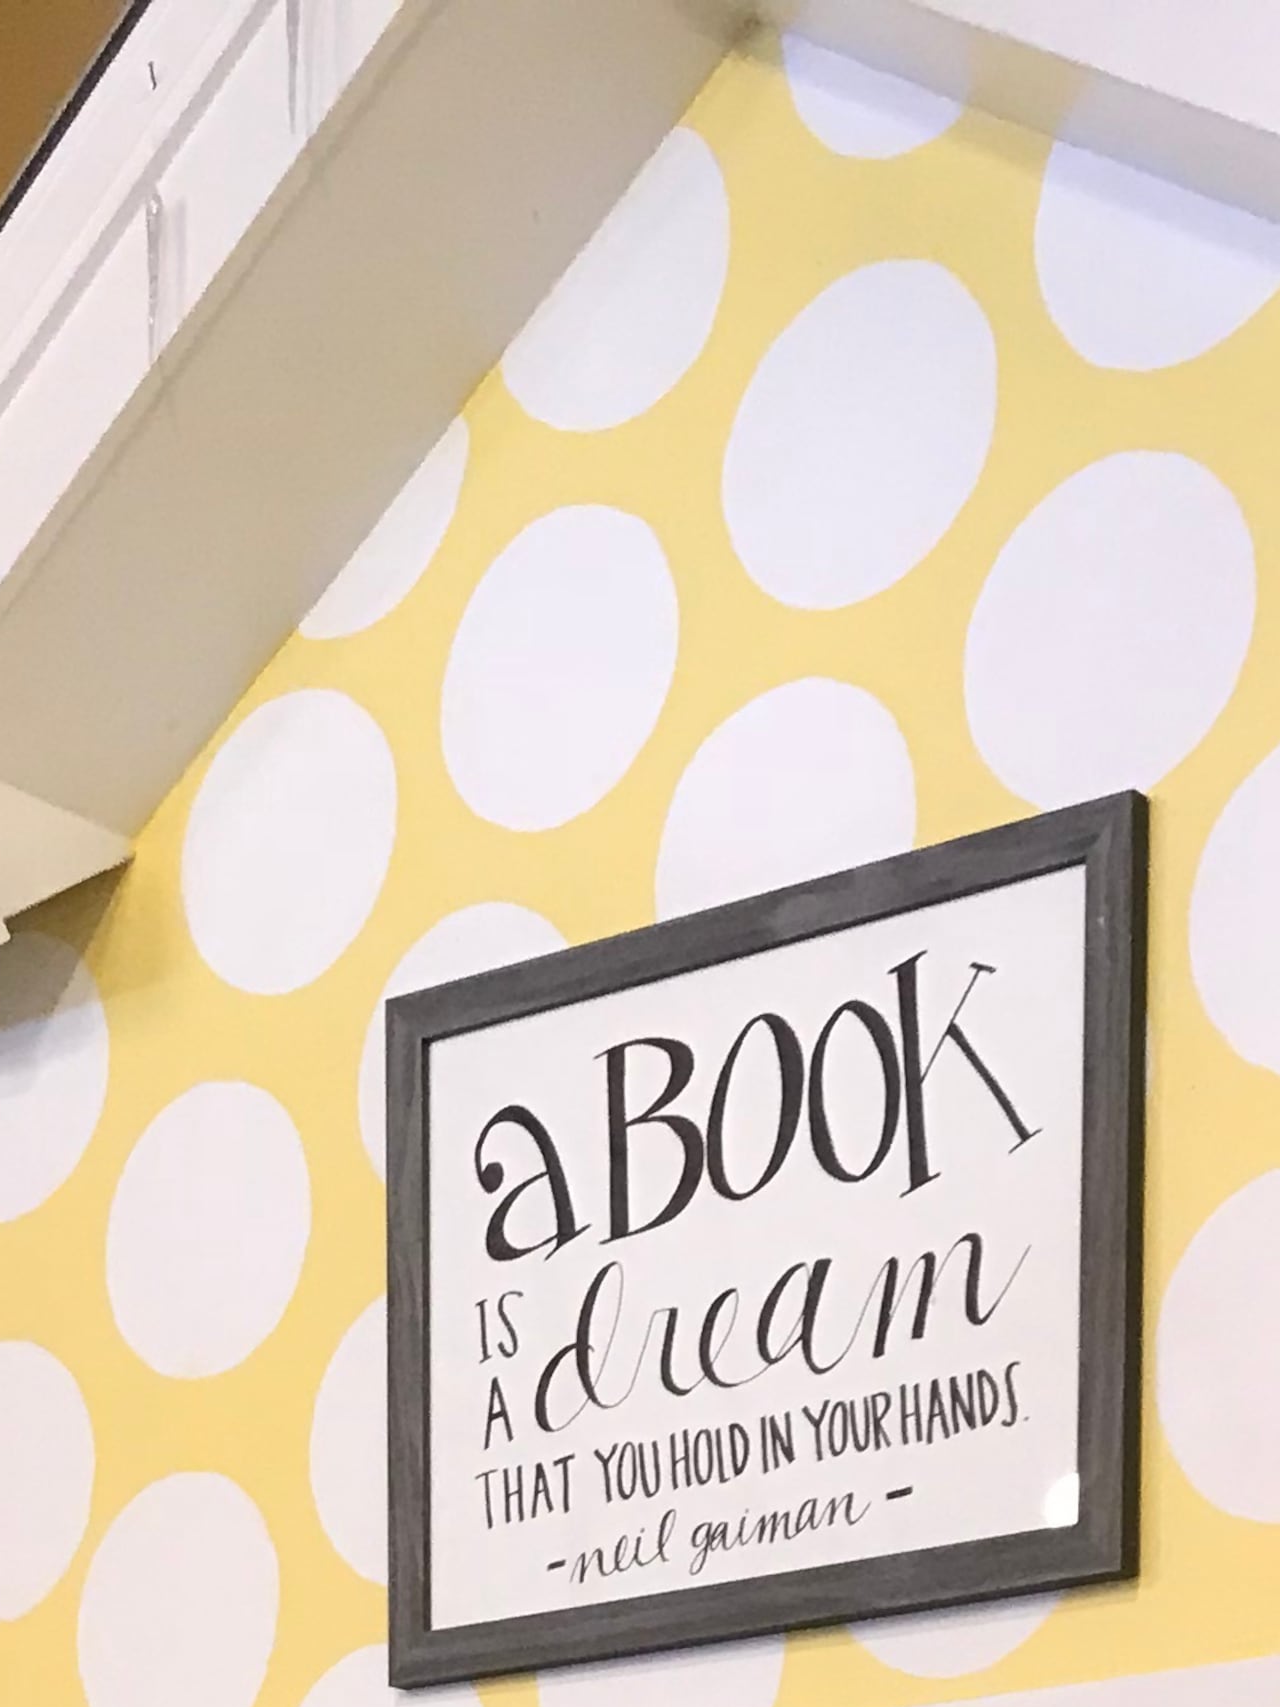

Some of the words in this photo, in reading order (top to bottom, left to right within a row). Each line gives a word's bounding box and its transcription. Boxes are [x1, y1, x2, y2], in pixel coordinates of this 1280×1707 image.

[474, 1104, 591, 1263] a
[594, 950, 1043, 1246] BOOK
[475, 1289, 524, 1364] IS
[534, 1233, 1032, 1434] dream
[476, 1454, 576, 1530] THAT
[594, 1438, 661, 1506] YOU
[669, 1421, 750, 1492] HOLD
[760, 1416, 796, 1472] IN
[802, 1395, 891, 1470] YOUR
[482, 1377, 513, 1450] A
[689, 1488, 870, 1574] gaiman
